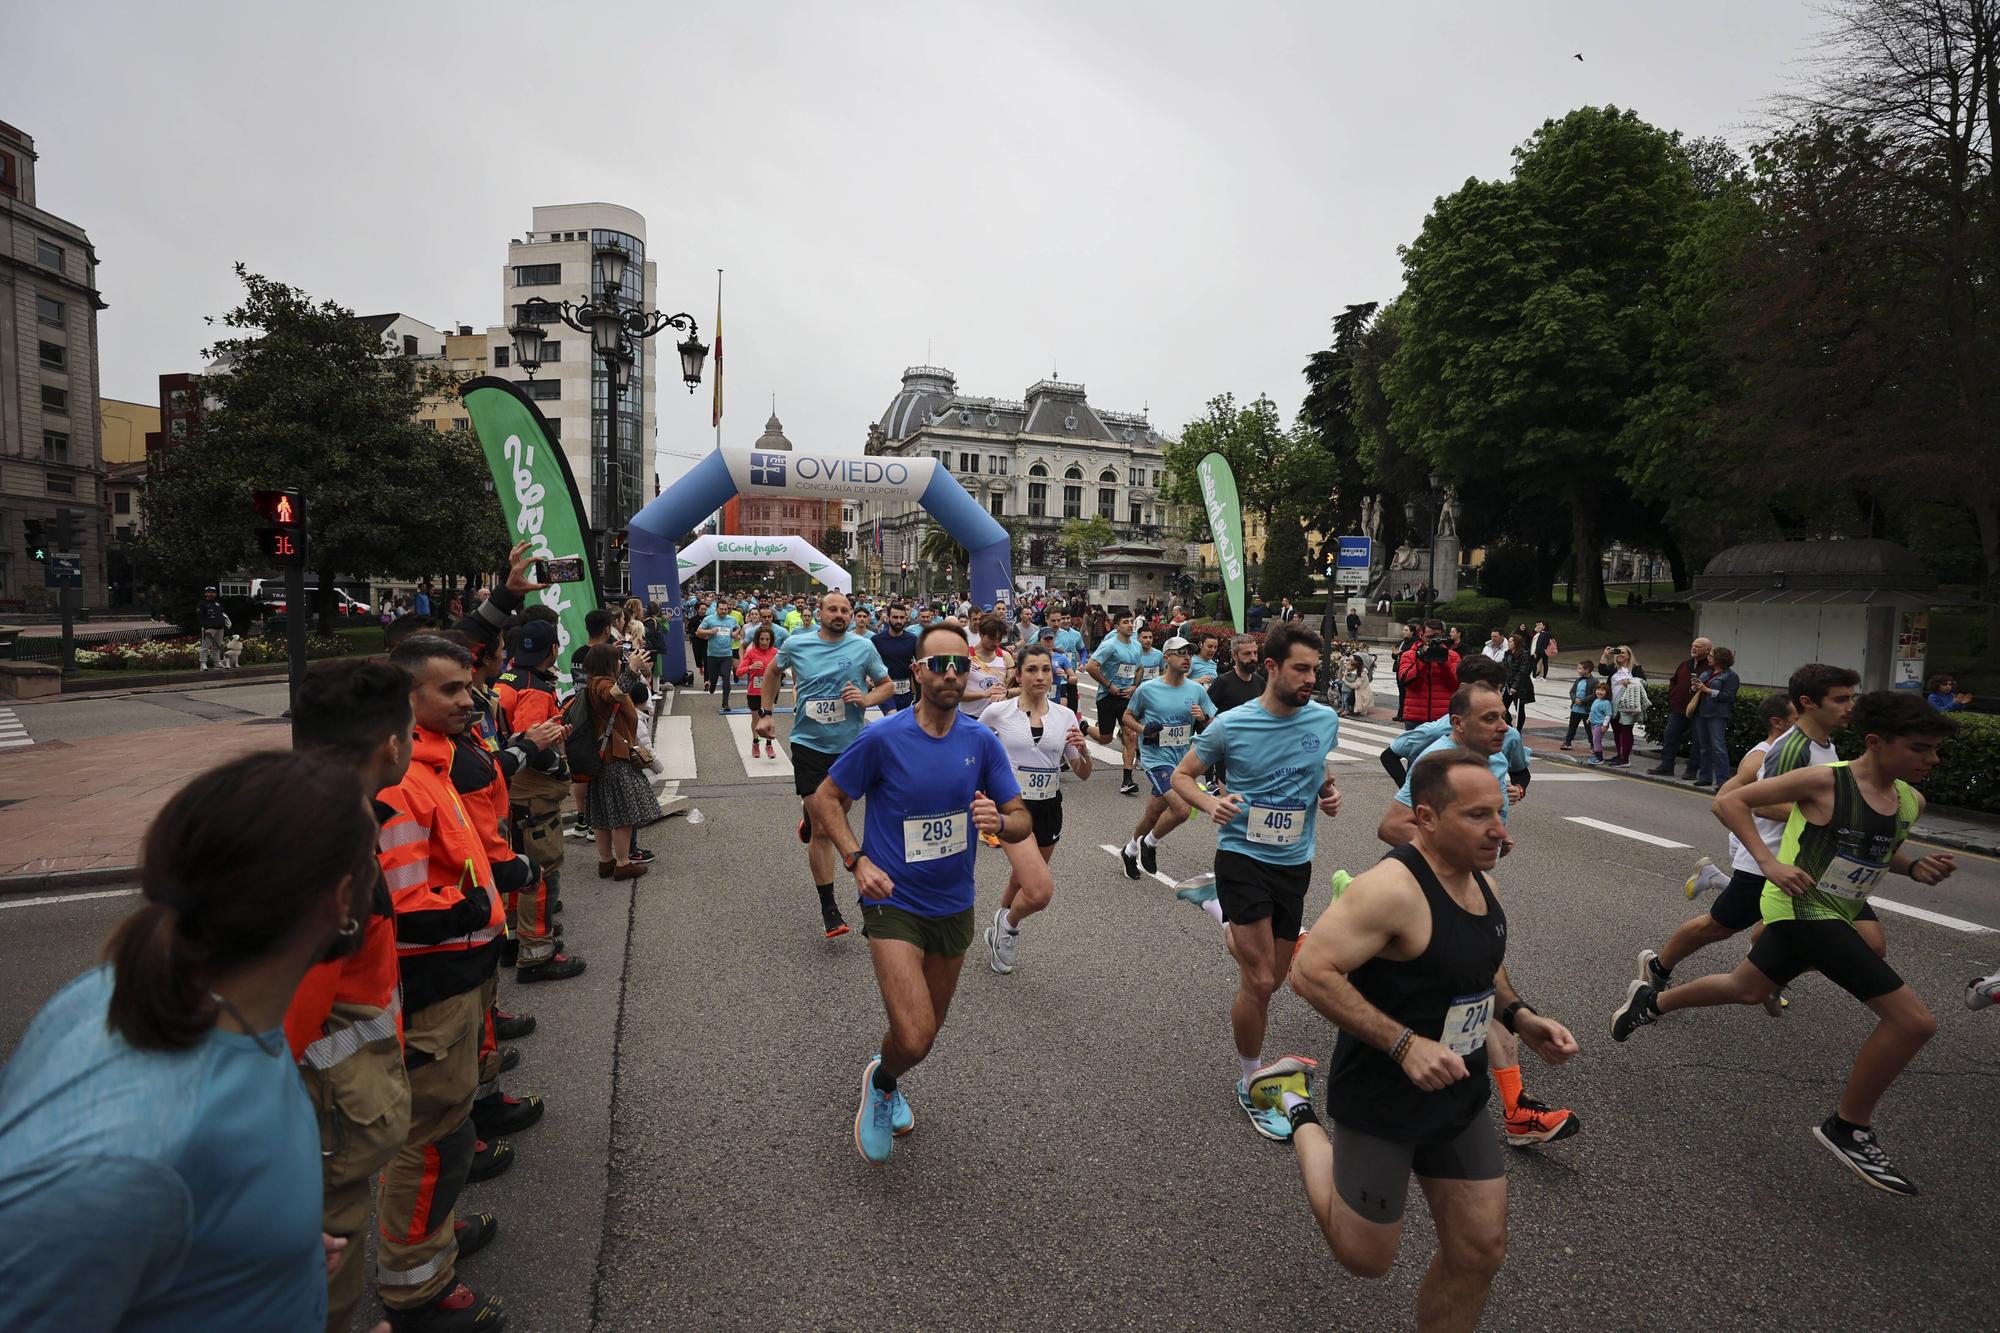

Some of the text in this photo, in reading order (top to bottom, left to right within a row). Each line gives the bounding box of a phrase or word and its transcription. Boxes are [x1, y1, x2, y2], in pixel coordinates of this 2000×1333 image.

[796, 457, 908, 485] OVIEDO
[795, 481, 909, 496] CONCEJALÍA DE DEPORTES
[274, 535, 295, 555] 36
[717, 540, 788, 556] El Corte Inglés
[816, 701, 836, 714] 324
[1168, 727, 1184, 738] 403
[1028, 774, 1051, 788] 387
[1263, 811, 1292, 830] 405
[922, 819, 953, 842] 293
[1461, 1001, 1489, 1034] 274
